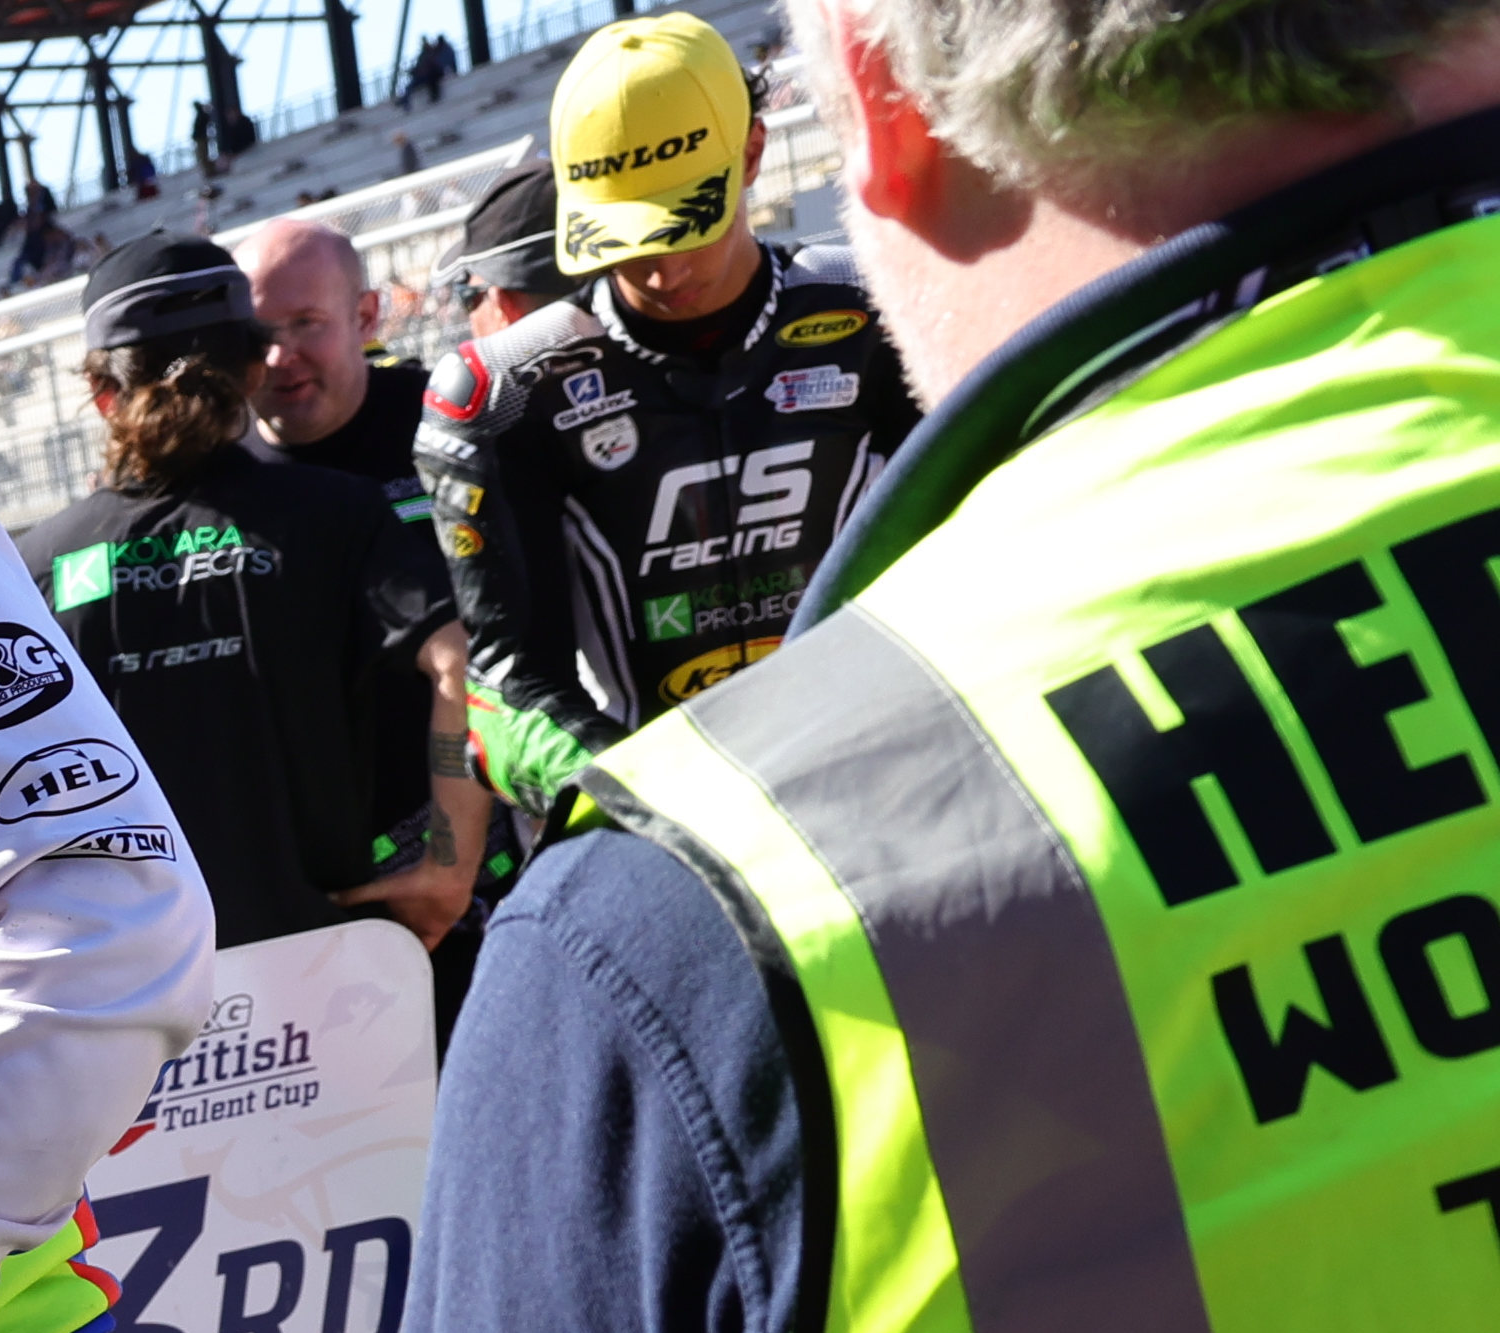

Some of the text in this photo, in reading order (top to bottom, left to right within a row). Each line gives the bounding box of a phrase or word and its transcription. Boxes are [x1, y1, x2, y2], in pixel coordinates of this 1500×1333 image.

[569, 128, 708, 182] DUNLOP
[111, 525, 245, 566] KOVARA
[112, 547, 275, 593] PROJECTS
[695, 589, 805, 633] PROJEC
[11, 674, 57, 696] PRODUCTS
[20, 759, 121, 807] HEL
[77, 832, 168, 855] XTON
[155, 1022, 312, 1094] ritish
[162, 1078, 321, 1132] Talent Cup
